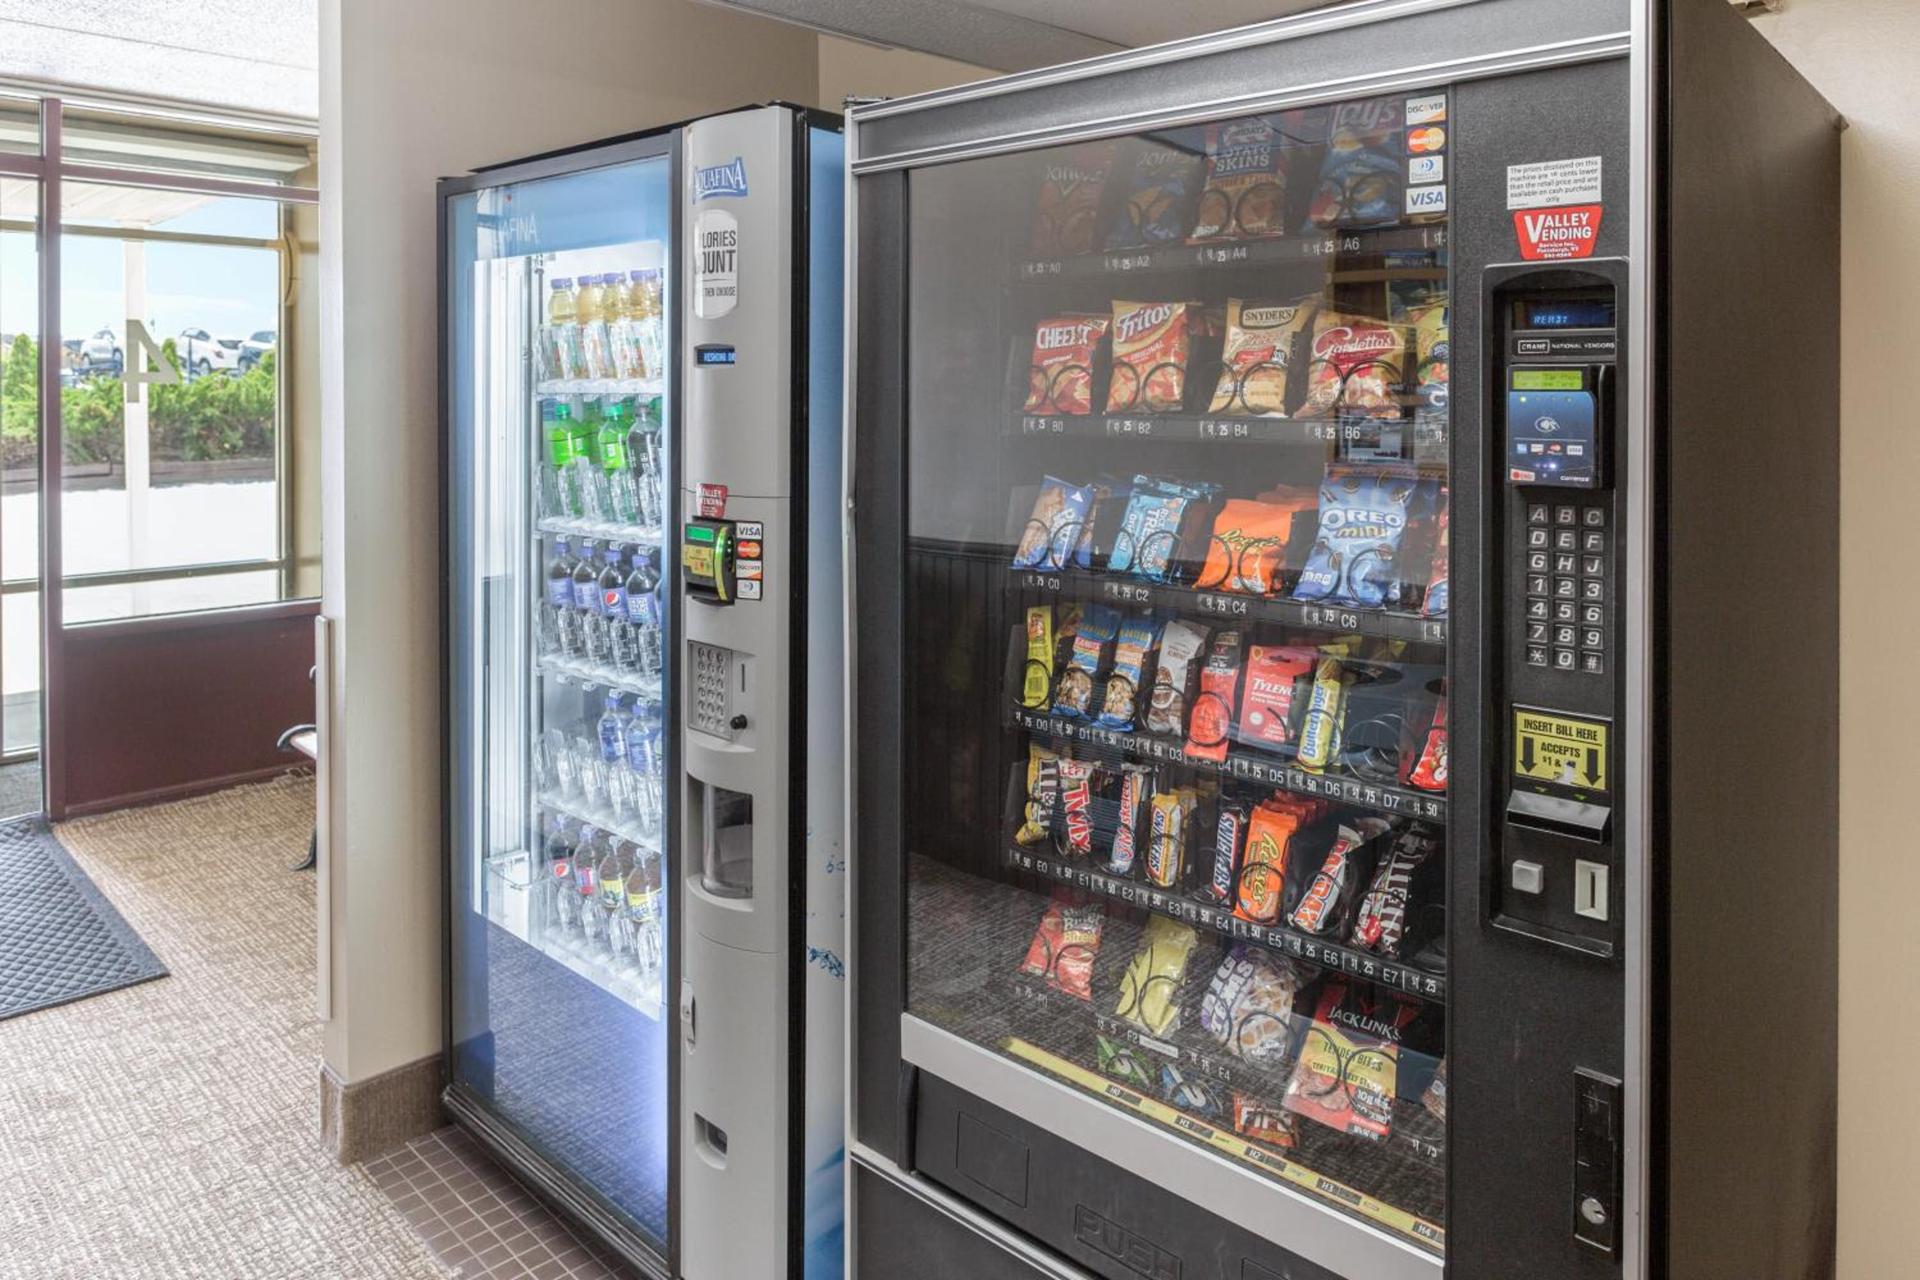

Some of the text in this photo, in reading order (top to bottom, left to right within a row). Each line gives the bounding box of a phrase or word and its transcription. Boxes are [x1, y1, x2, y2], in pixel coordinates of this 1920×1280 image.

[1216, 154, 1270, 172] SKINS
[1410, 192, 1444, 206] VISA
[1524, 212, 1589, 238] VALLEY
[702, 230, 736, 248] LORIES
[1344, 237, 1360, 251] A6
[702, 249, 736, 274] OUNT
[1116, 304, 1172, 343] Fritos
[1521, 342, 1547, 351] CRANE
[1584, 342, 1615, 350] VENDORS
[1234, 424, 1248, 437] B4
[1345, 426, 1360, 440] B6
[1321, 509, 1403, 528] OREO
[1532, 508, 1545, 521] A
[1559, 509, 1572, 522] B
[1587, 511, 1600, 524] C
[738, 527, 761, 537] VISA
[1334, 524, 1392, 539] mini
[1531, 531, 1545, 545] D
[1559, 533, 1572, 547] E
[1587, 535, 1600, 548] F
[1531, 554, 1545, 568] G
[1558, 557, 1573, 571] H
[1587, 559, 1599, 573] J
[1535, 579, 1543, 592] 1
[1559, 581, 1572, 594] 2
[1587, 583, 1599, 597] 3
[1135, 589, 1149, 601] C2
[1232, 600, 1246, 614] C4
[1531, 602, 1544, 615] 4
[1559, 604, 1572, 618] 5
[1587, 607, 1600, 621] 6
[1341, 613, 1357, 628] C6
[1533, 625, 1544, 638] 7
[1559, 628, 1572, 642] 8
[1587, 631, 1600, 645] 9
[1587, 656, 1598, 669] #
[1253, 678, 1292, 697] TYLEN
[1524, 718, 1598, 742] INSERT BILL HERE
[1541, 741, 1581, 759] ACCEPTS
[1542, 756, 1552, 766] $1
[1554, 759, 1562, 768] &
[1269, 769, 1284, 784] D5
[1325, 782, 1340, 797] D6
[1383, 794, 1399, 809] D7
[1413, 801, 1438, 816] $1.50
[1062, 780, 1092, 854] TWIX
[1214, 812, 1236, 891] SNICKERS
[1122, 887, 1134, 900] E2
[1168, 901, 1181, 915] E3
[1216, 917, 1229, 930] E4
[1268, 933, 1283, 948] E5
[1323, 949, 1339, 965] E6
[1383, 968, 1399, 983] E7
[1327, 1006, 1359, 1028] JACK
[1418, 1224, 1431, 1236] H4
[1079, 1208, 1178, 1280] PUSH
